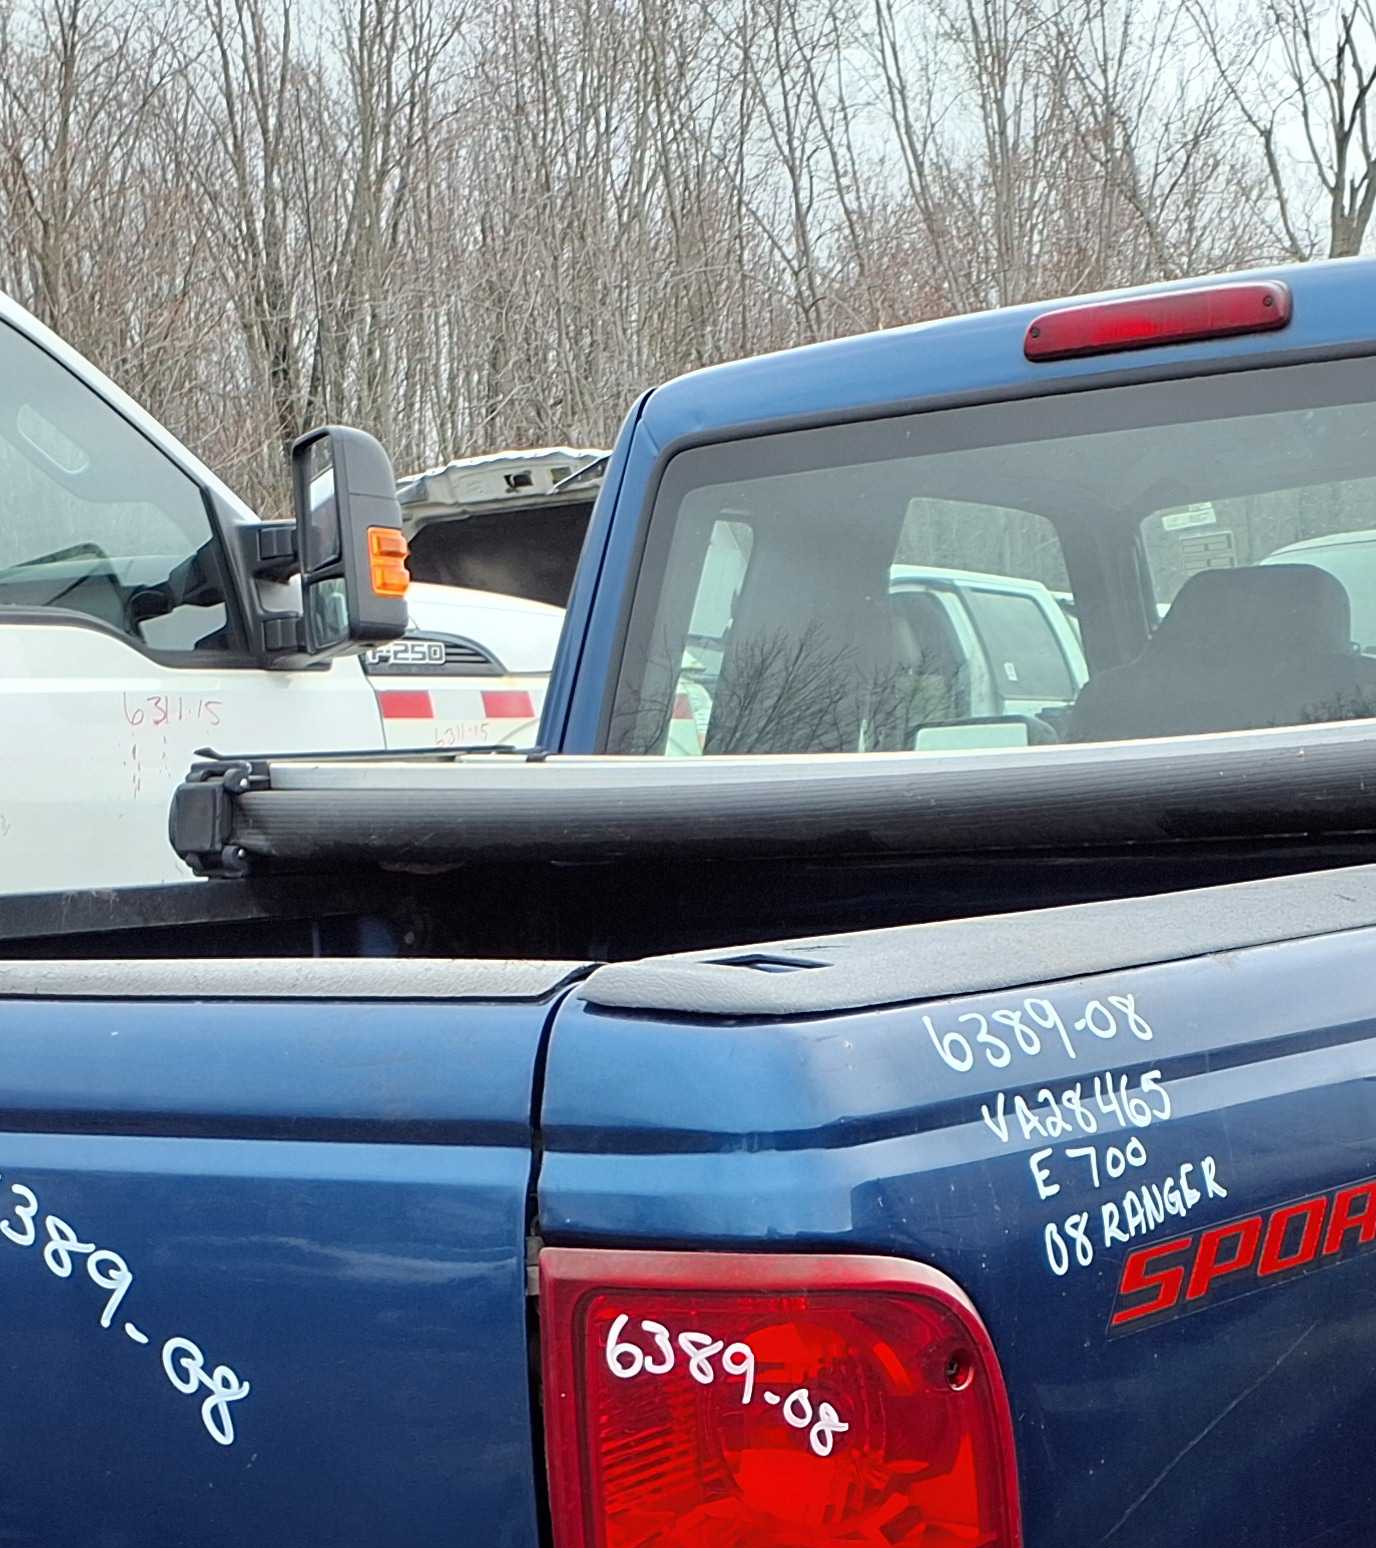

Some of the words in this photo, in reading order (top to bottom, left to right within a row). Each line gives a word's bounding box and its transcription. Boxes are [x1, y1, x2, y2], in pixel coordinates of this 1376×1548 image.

[980, 1070, 1172, 1143] VA28465
[1029, 1147, 1060, 1200] E
[1065, 1136, 1147, 1188] 700
[1044, 1212, 1094, 1276] 08
[1101, 1156, 1228, 1248] RANGER
[605, 1313, 849, 1457] 6389-08
